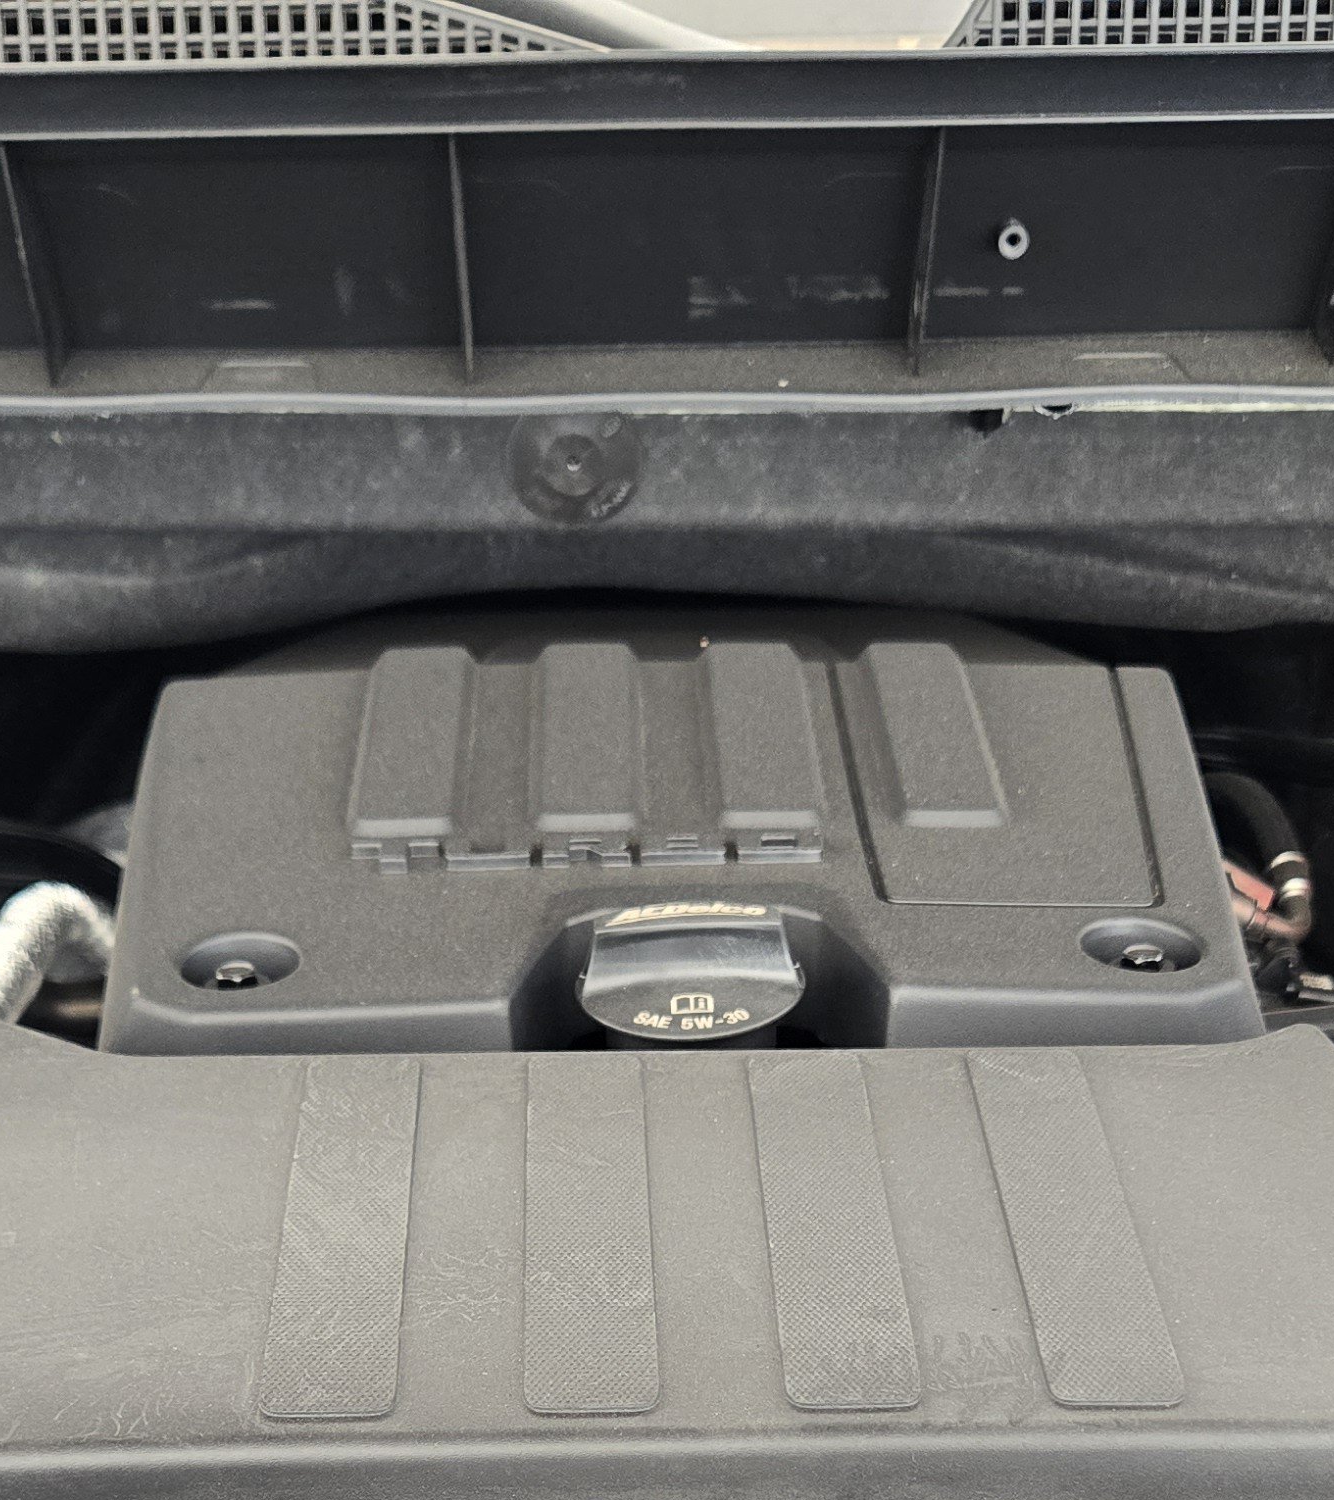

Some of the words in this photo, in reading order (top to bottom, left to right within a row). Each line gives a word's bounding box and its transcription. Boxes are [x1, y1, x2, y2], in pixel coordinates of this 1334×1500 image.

[605, 903, 766, 926] ACDelco
[633, 1010, 673, 1029] SAE
[681, 1008, 750, 1030] 5W-30
